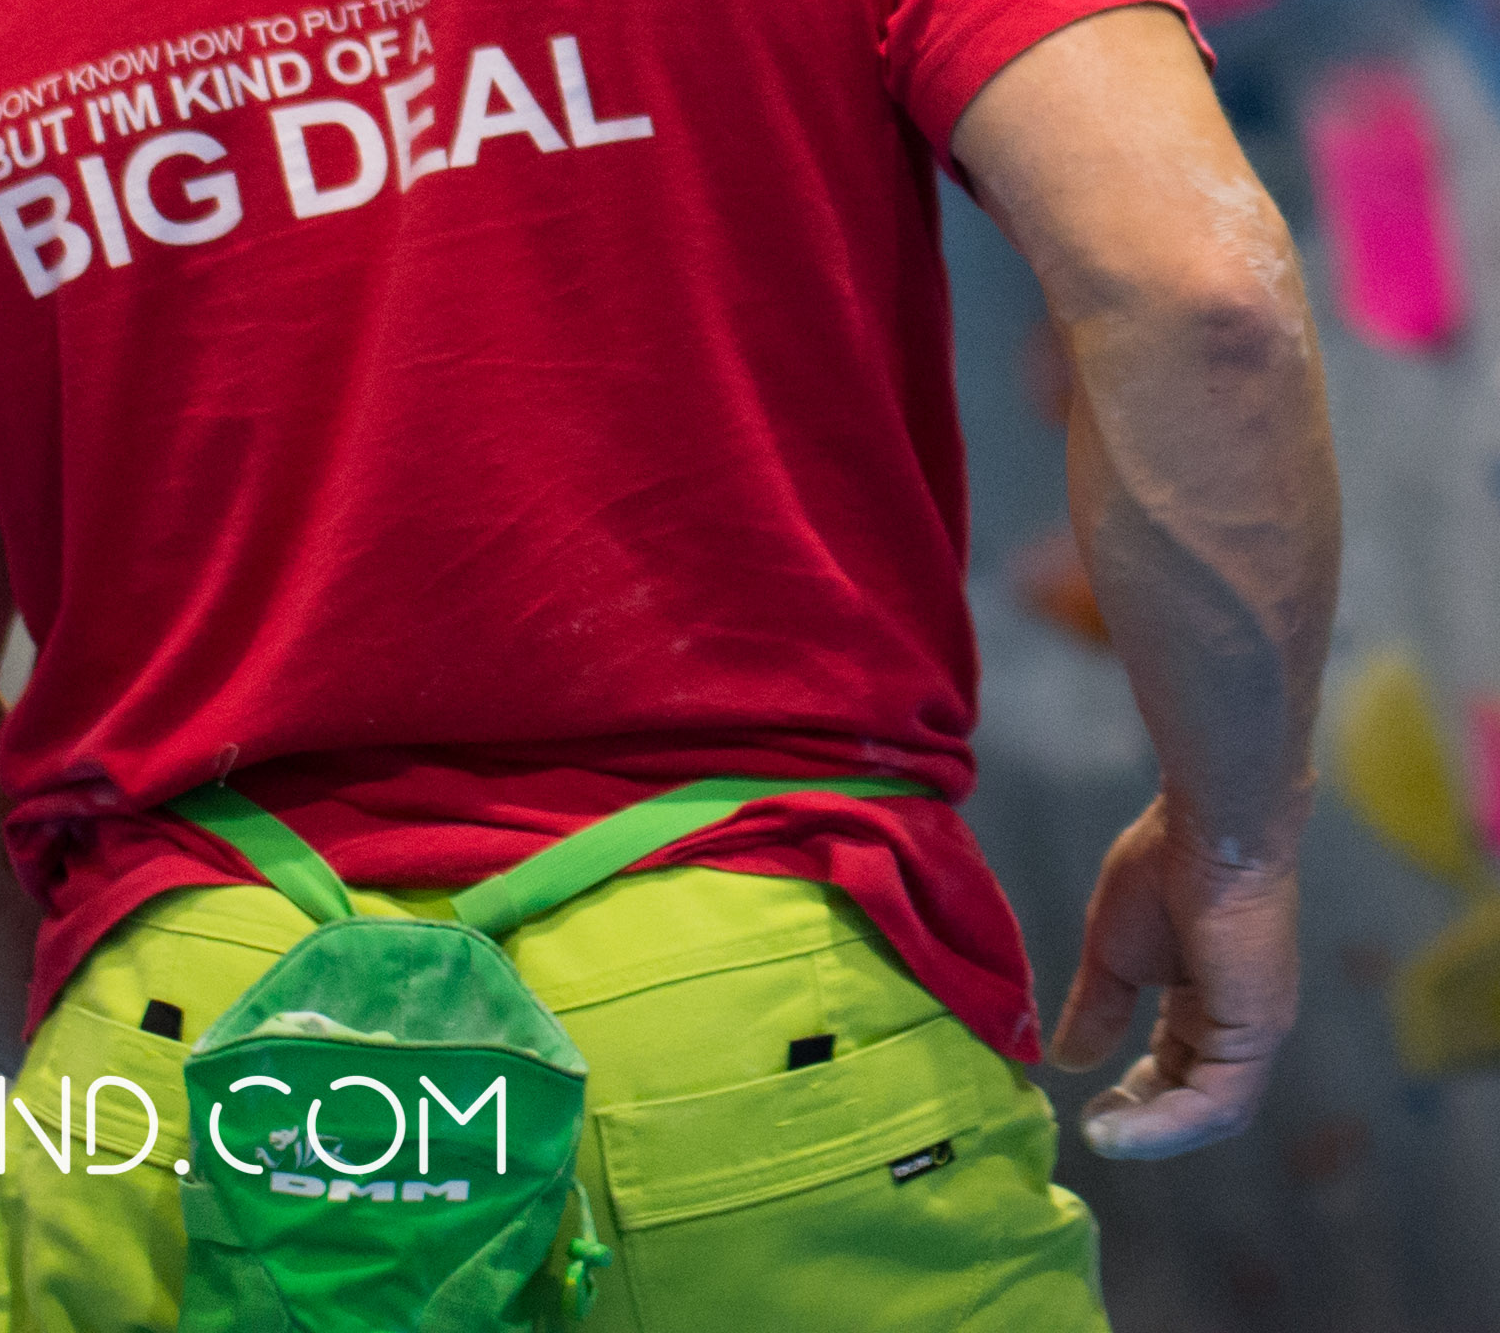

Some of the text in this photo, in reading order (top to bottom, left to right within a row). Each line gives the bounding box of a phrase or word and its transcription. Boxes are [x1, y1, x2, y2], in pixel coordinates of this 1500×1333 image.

[67, 46, 159, 96] KNOW
[165, 26, 243, 67] HOW
[250, 17, 296, 47] TO
[303, 1, 364, 38] PUT
[86, 82, 162, 144] I'M
[169, 51, 312, 120] KIND
[325, 29, 400, 85] OF
[410, 18, 433, 64] A
[270, 33, 655, 220] DEAL
[270, 1171, 470, 1202] DMM
